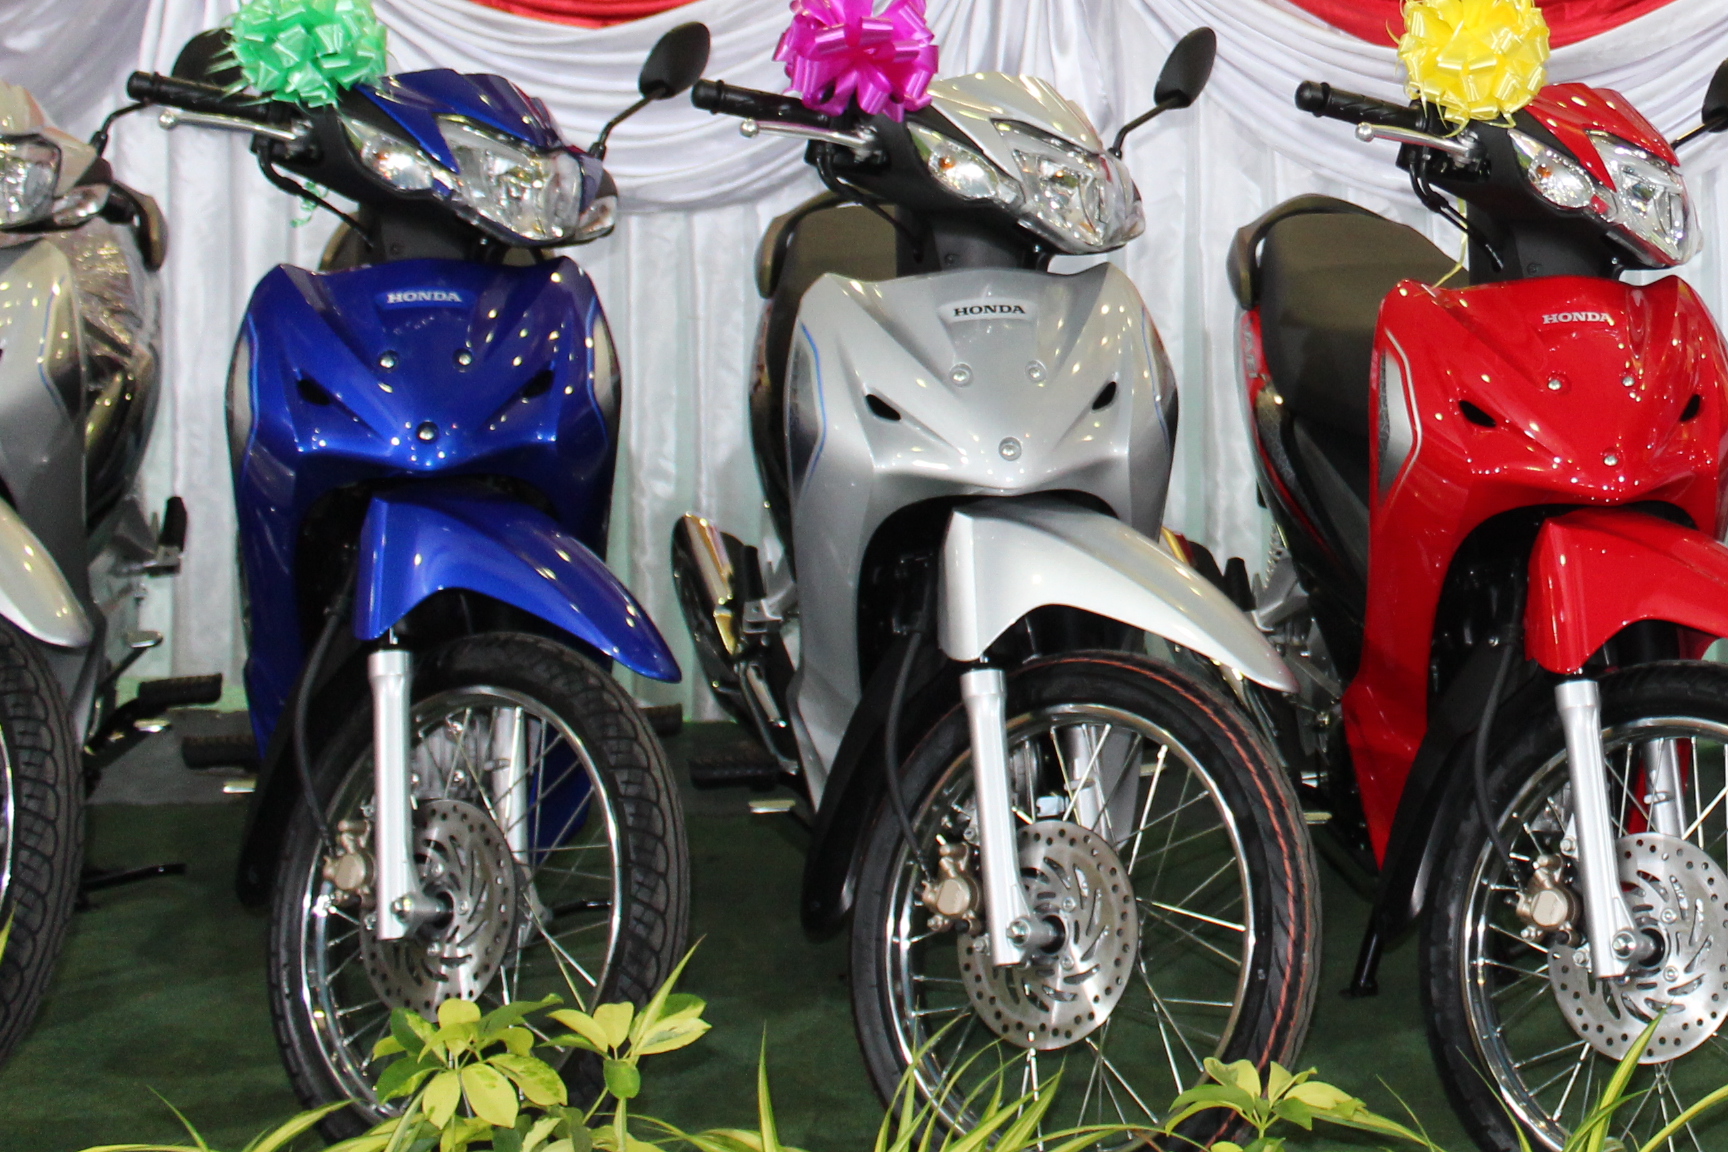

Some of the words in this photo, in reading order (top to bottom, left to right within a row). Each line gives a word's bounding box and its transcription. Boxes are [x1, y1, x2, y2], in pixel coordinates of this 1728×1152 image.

[386, 290, 463, 304] HONDA
[953, 304, 1026, 317] HONDA
[1541, 311, 1615, 326] HONDA
